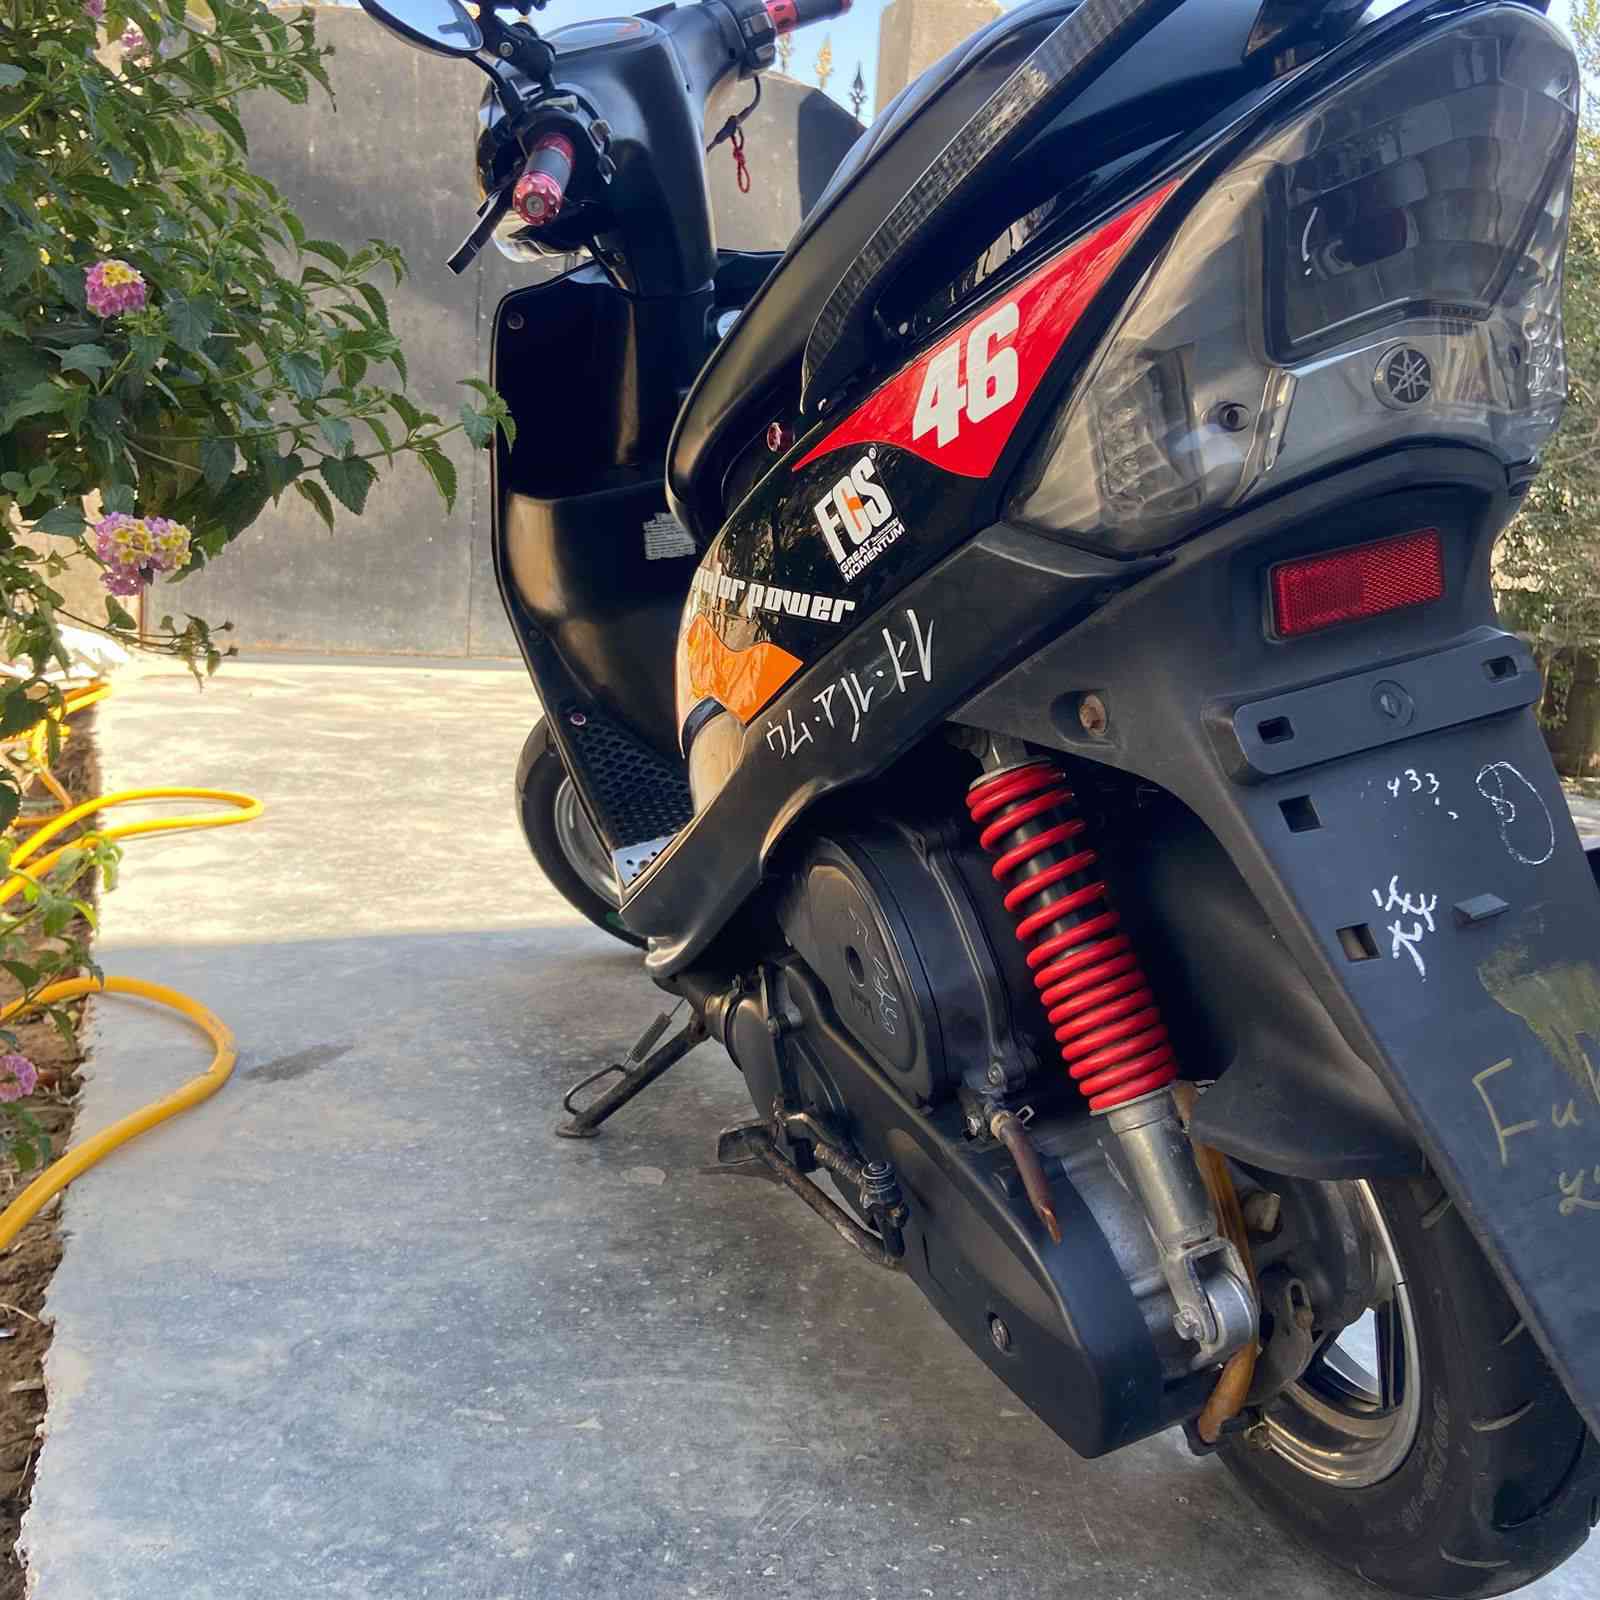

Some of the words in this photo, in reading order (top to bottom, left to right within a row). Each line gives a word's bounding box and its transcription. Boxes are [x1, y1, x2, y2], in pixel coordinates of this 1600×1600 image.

[912, 301, 1020, 449] 46
[839, 541, 872, 573] GREAT
[844, 523, 906, 582] MOMENTUM
[747, 583, 856, 624] power
